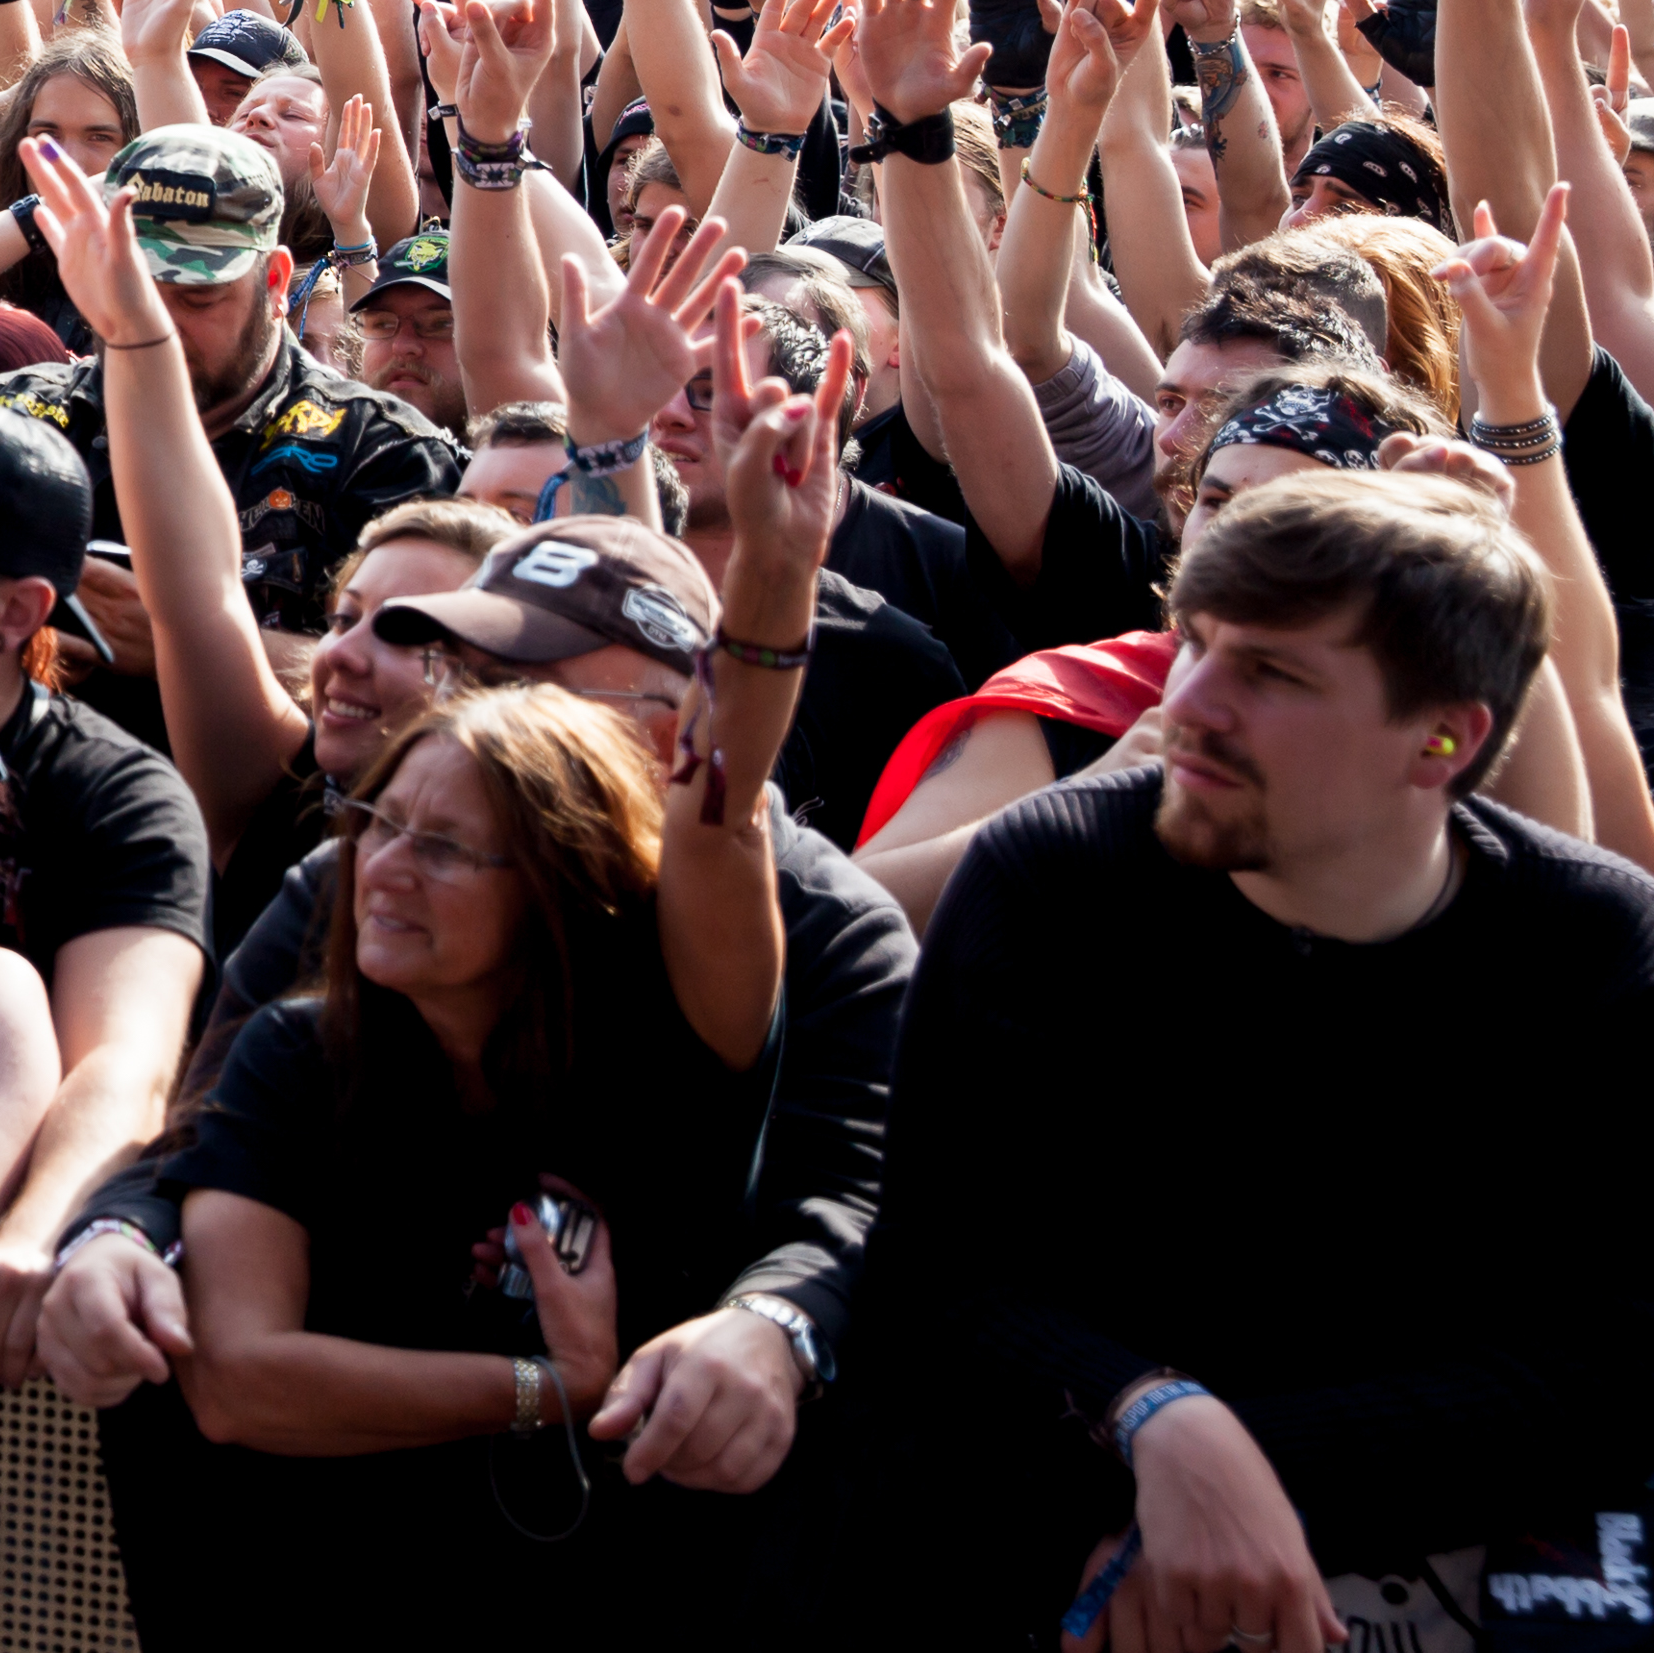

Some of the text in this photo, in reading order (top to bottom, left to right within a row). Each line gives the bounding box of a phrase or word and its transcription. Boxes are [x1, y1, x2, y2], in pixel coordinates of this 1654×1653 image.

[126, 172, 209, 207] Sabaton
[512, 540, 600, 588] 8
[1488, 1572, 1652, 1624] Sabbath
